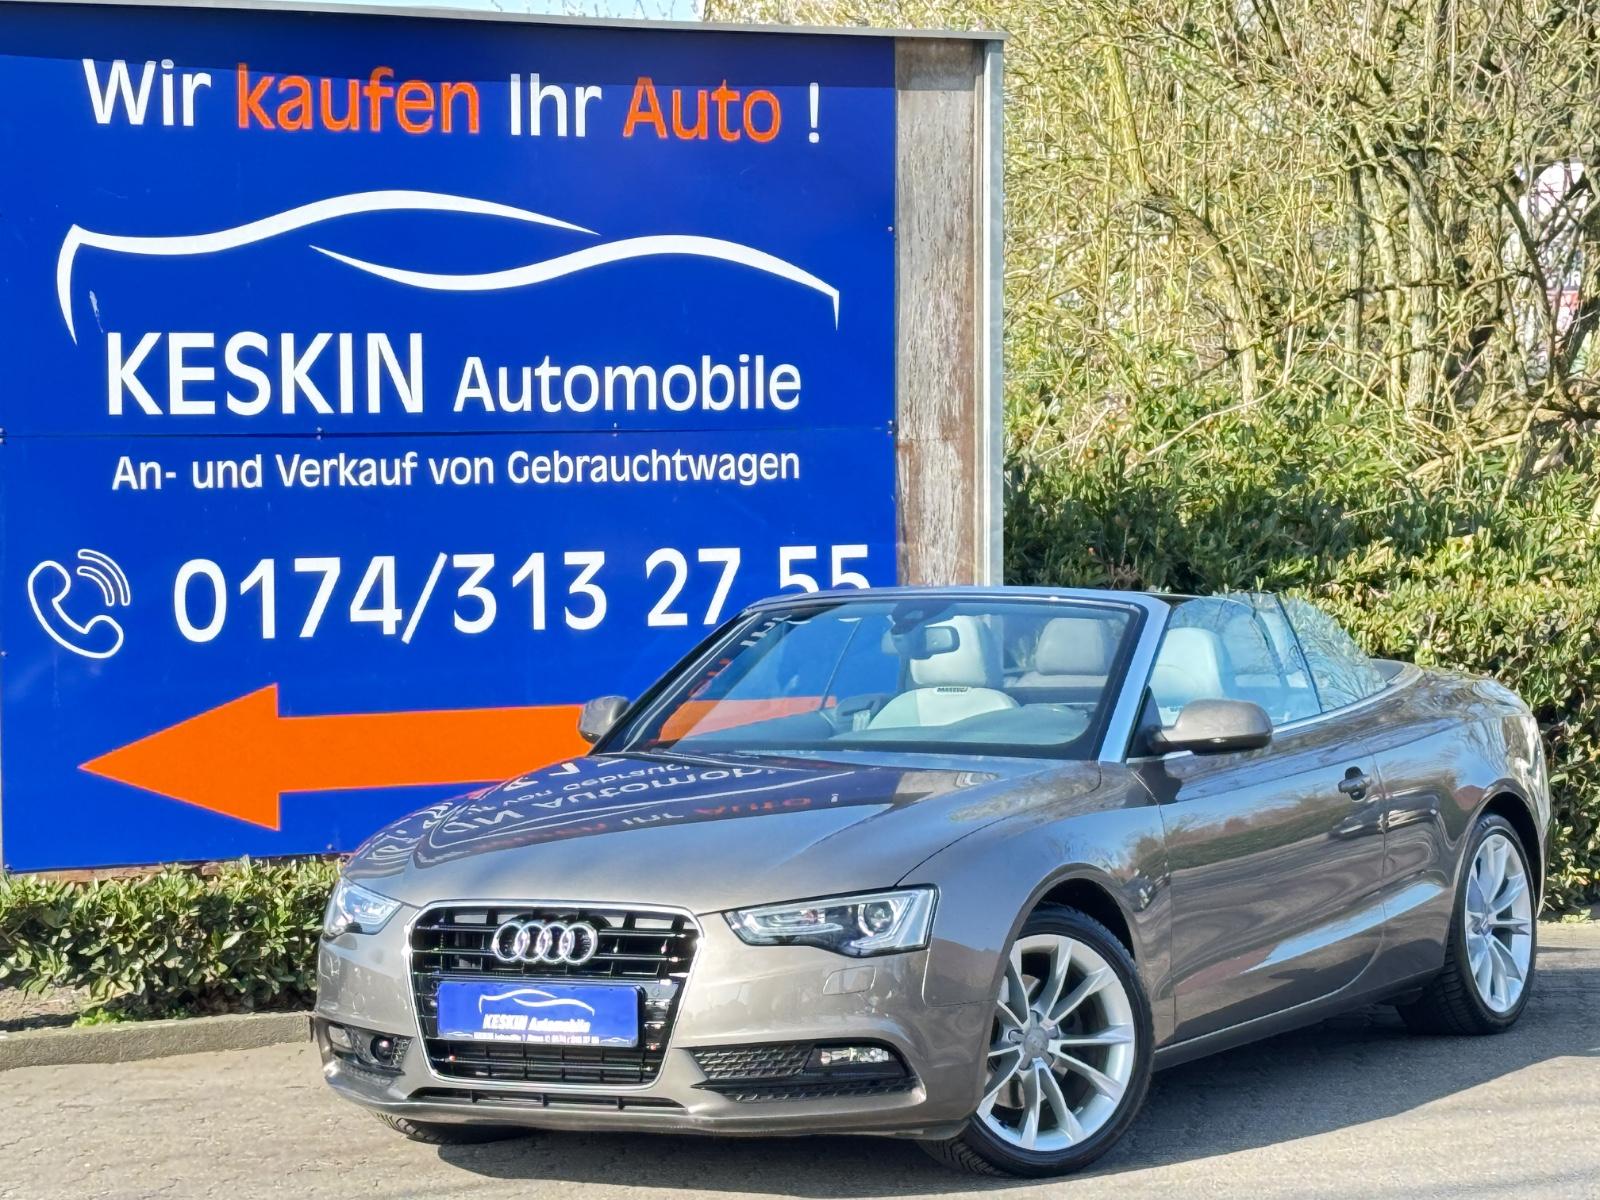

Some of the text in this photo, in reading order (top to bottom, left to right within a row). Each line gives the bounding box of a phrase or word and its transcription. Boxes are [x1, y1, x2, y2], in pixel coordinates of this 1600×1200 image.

[82, 58, 820, 144] Wir kaufen Ihr Auto !
[107, 331, 802, 416] KESKIN Automobile
[111, 448, 800, 491] An- und Verkauf von Gebrauchtwagen
[173, 550, 607, 645] 0174/313
[645, 547, 741, 627] 27
